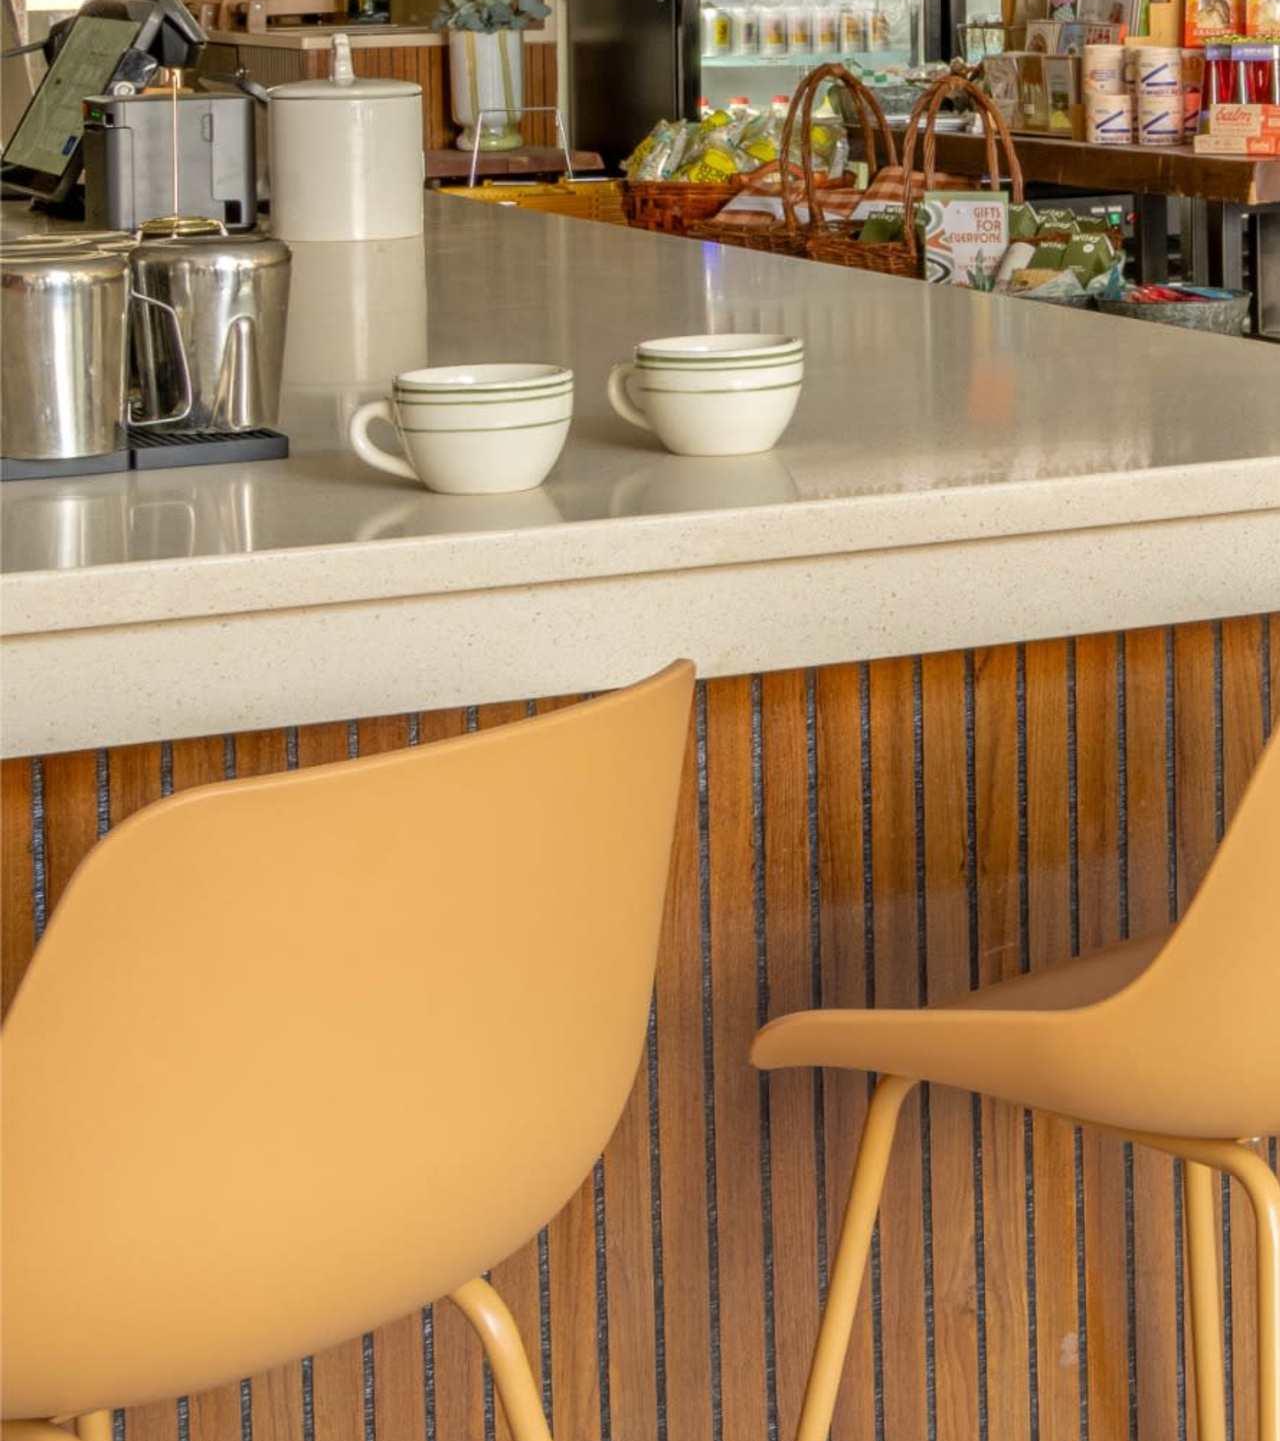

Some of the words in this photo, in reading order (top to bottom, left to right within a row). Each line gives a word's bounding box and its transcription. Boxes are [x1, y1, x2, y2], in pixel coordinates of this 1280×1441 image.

[974, 208, 1000, 218] GIFTS
[976, 220, 1000, 231] FOR
[951, 232, 1001, 243] EVERYONE
